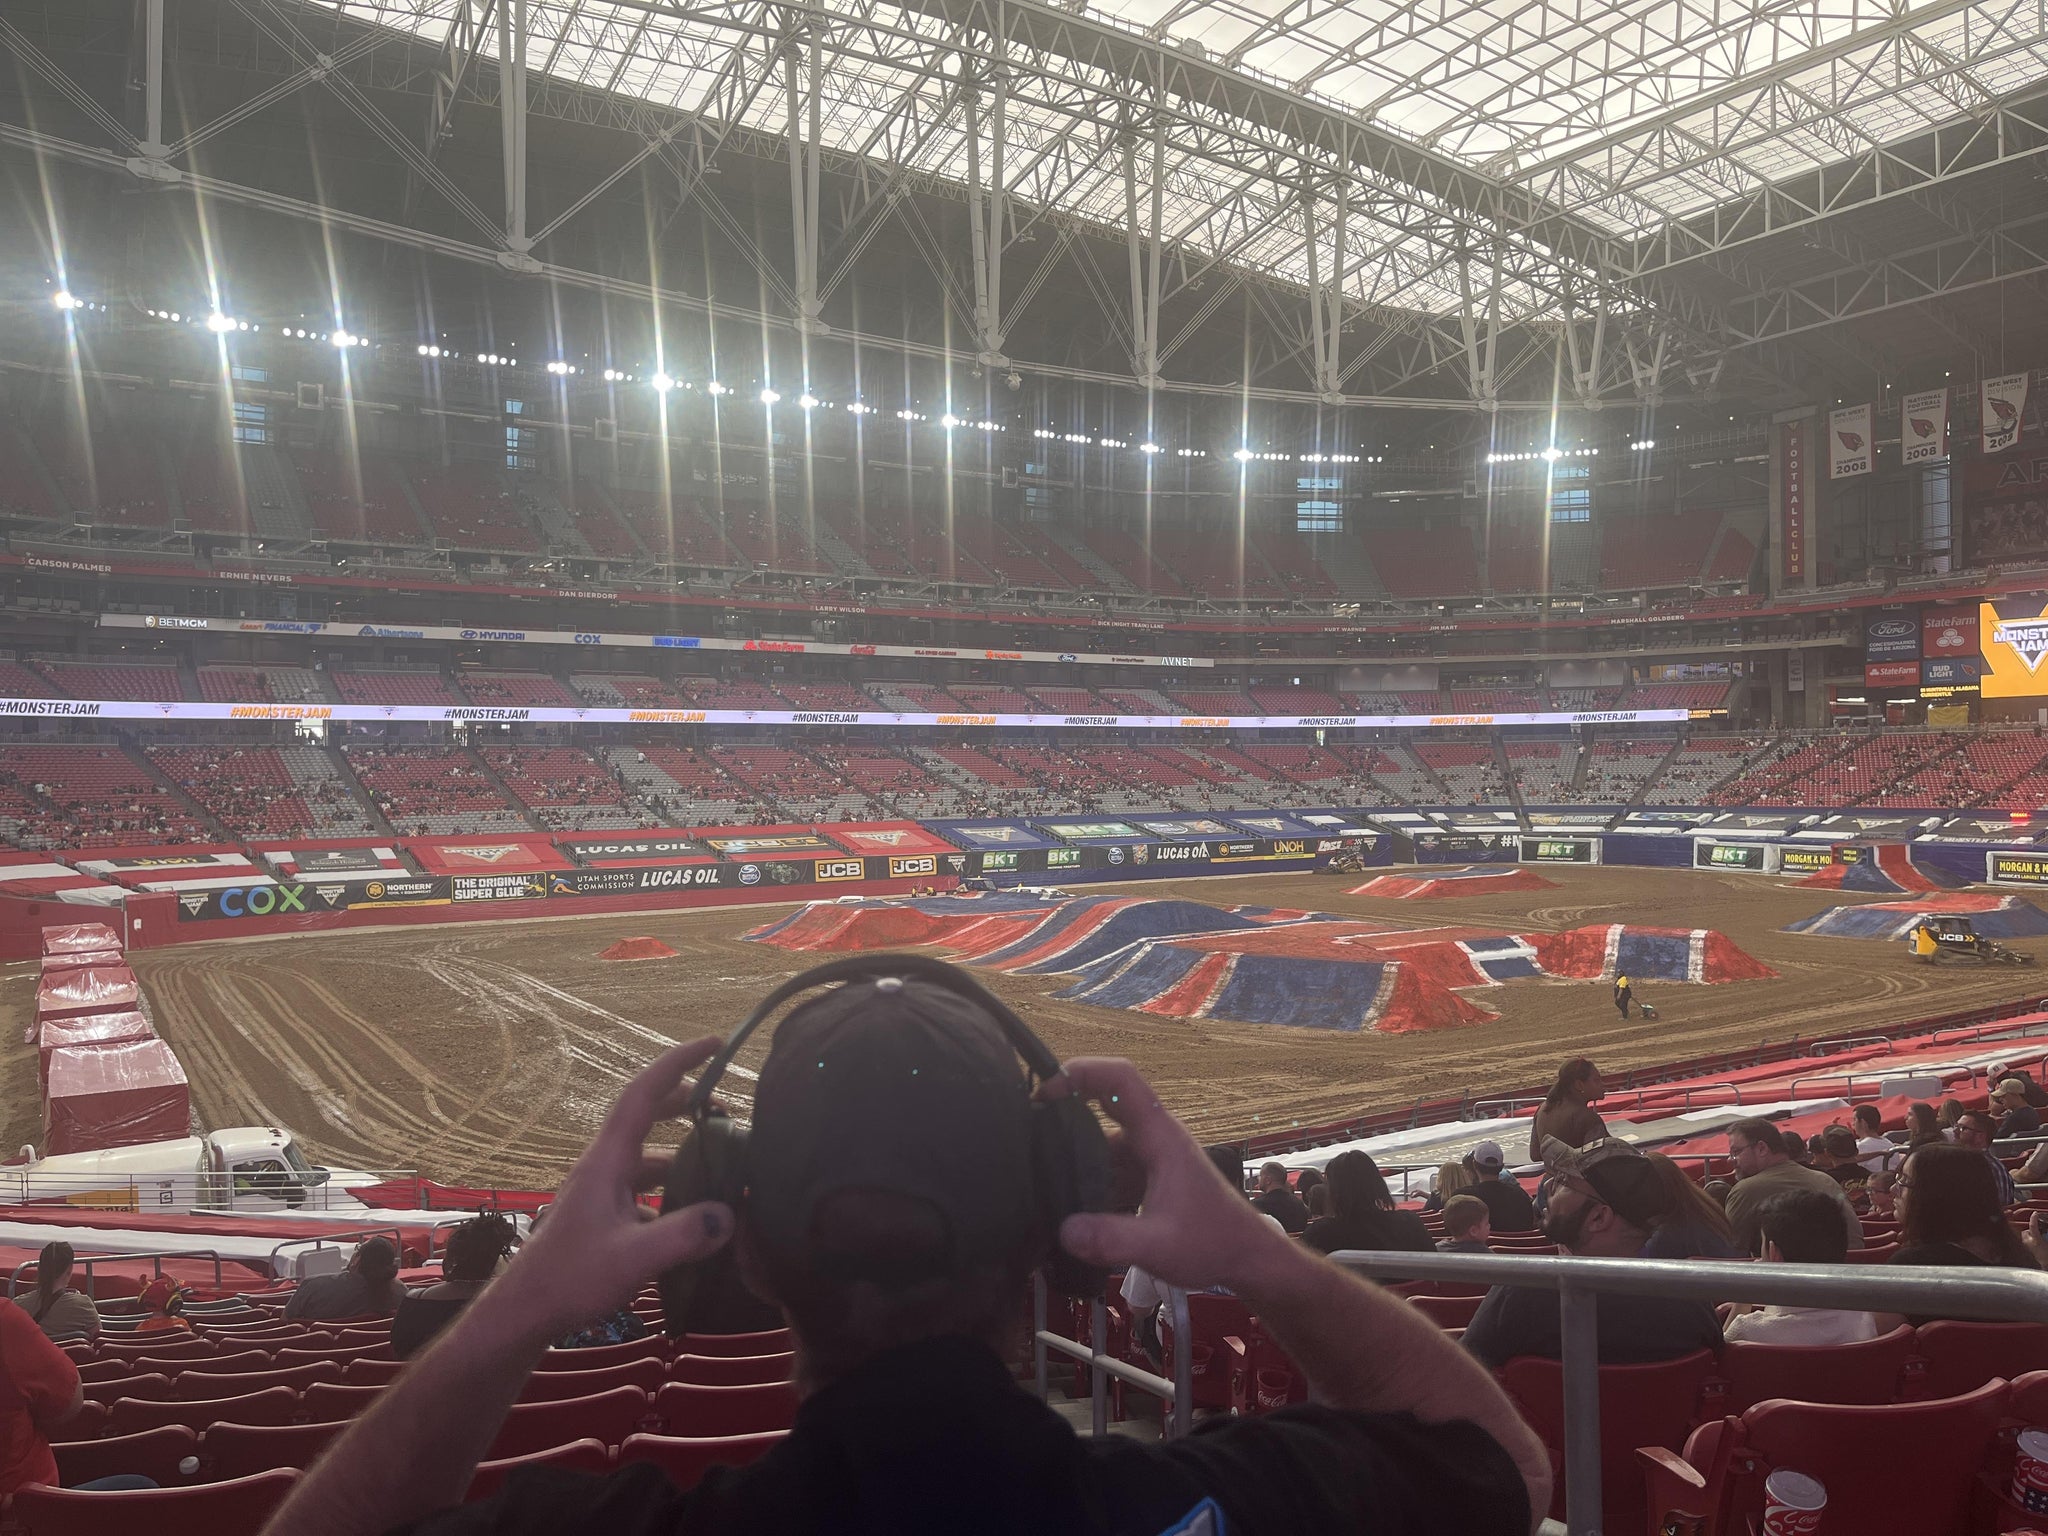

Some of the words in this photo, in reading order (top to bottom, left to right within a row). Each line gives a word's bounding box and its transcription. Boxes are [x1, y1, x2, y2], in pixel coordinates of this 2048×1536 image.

[2003, 376, 2023, 386] WEST
[1907, 393, 1942, 404] NATIONAL
[1906, 446, 1937, 460] 2008
[1836, 461, 1867, 474] 2008
[1790, 438, 1798, 527] FOOTBALL
[1791, 531, 1799, 573] CLUB
[28, 557, 70, 569] CARSON
[72, 562, 112, 573] PALMER
[220, 571, 250, 580] ERNIE
[252, 573, 293, 582] NEVERS
[560, 590, 576, 598] DAN
[159, 617, 208, 628] BETMGM
[479, 631, 525, 641] HYUNDAI
[574, 634, 602, 644] COX
[2016, 639, 2048, 652] JAM
[1161, 656, 1193, 667] AVNET
[1929, 670, 1954, 678] LIGHT
[1932, 664, 1950, 672] BUD
[0, 701, 100, 715] #MONSTERJAM
[230, 706, 332, 720] #MONSTERJAM
[444, 708, 530, 720] #MONSTERJAM
[629, 710, 706, 722] #MONSTERJAM
[792, 713, 859, 724] #MONSTERJAM
[1064, 716, 1117, 726] #MONSTERJAM
[1298, 717, 1356, 727] #MONSTERJAM
[1572, 711, 1637, 722] #MONSTERJAM
[575, 844, 649, 855] LUCAS
[1274, 840, 1304, 853] UNOH
[1538, 844, 1574, 856] BKT
[1048, 850, 1080, 863] BKT
[1157, 847, 1190, 859] LUCAS
[1712, 848, 1748, 861] BKT
[1785, 853, 1812, 864] MORGAN
[893, 858, 934, 874] JCB
[983, 853, 1017, 867] BKT
[819, 862, 861, 878] JCB
[1999, 861, 2033, 873] MORGAN
[2034, 863, 2041, 873] &
[454, 878, 477, 889] THE
[478, 876, 530, 888] ORIGINAL
[577, 874, 600, 883] UTAH
[603, 873, 635, 881] SPORTS
[640, 869, 692, 887] LUCAS
[386, 883, 432, 891] NORTHERN
[577, 881, 635, 890] COMMISSION
[455, 888, 495, 900] SUPER
[496, 886, 525, 898] GLUE
[219, 884, 306, 918] COX
[1938, 933, 1964, 942] JCB
